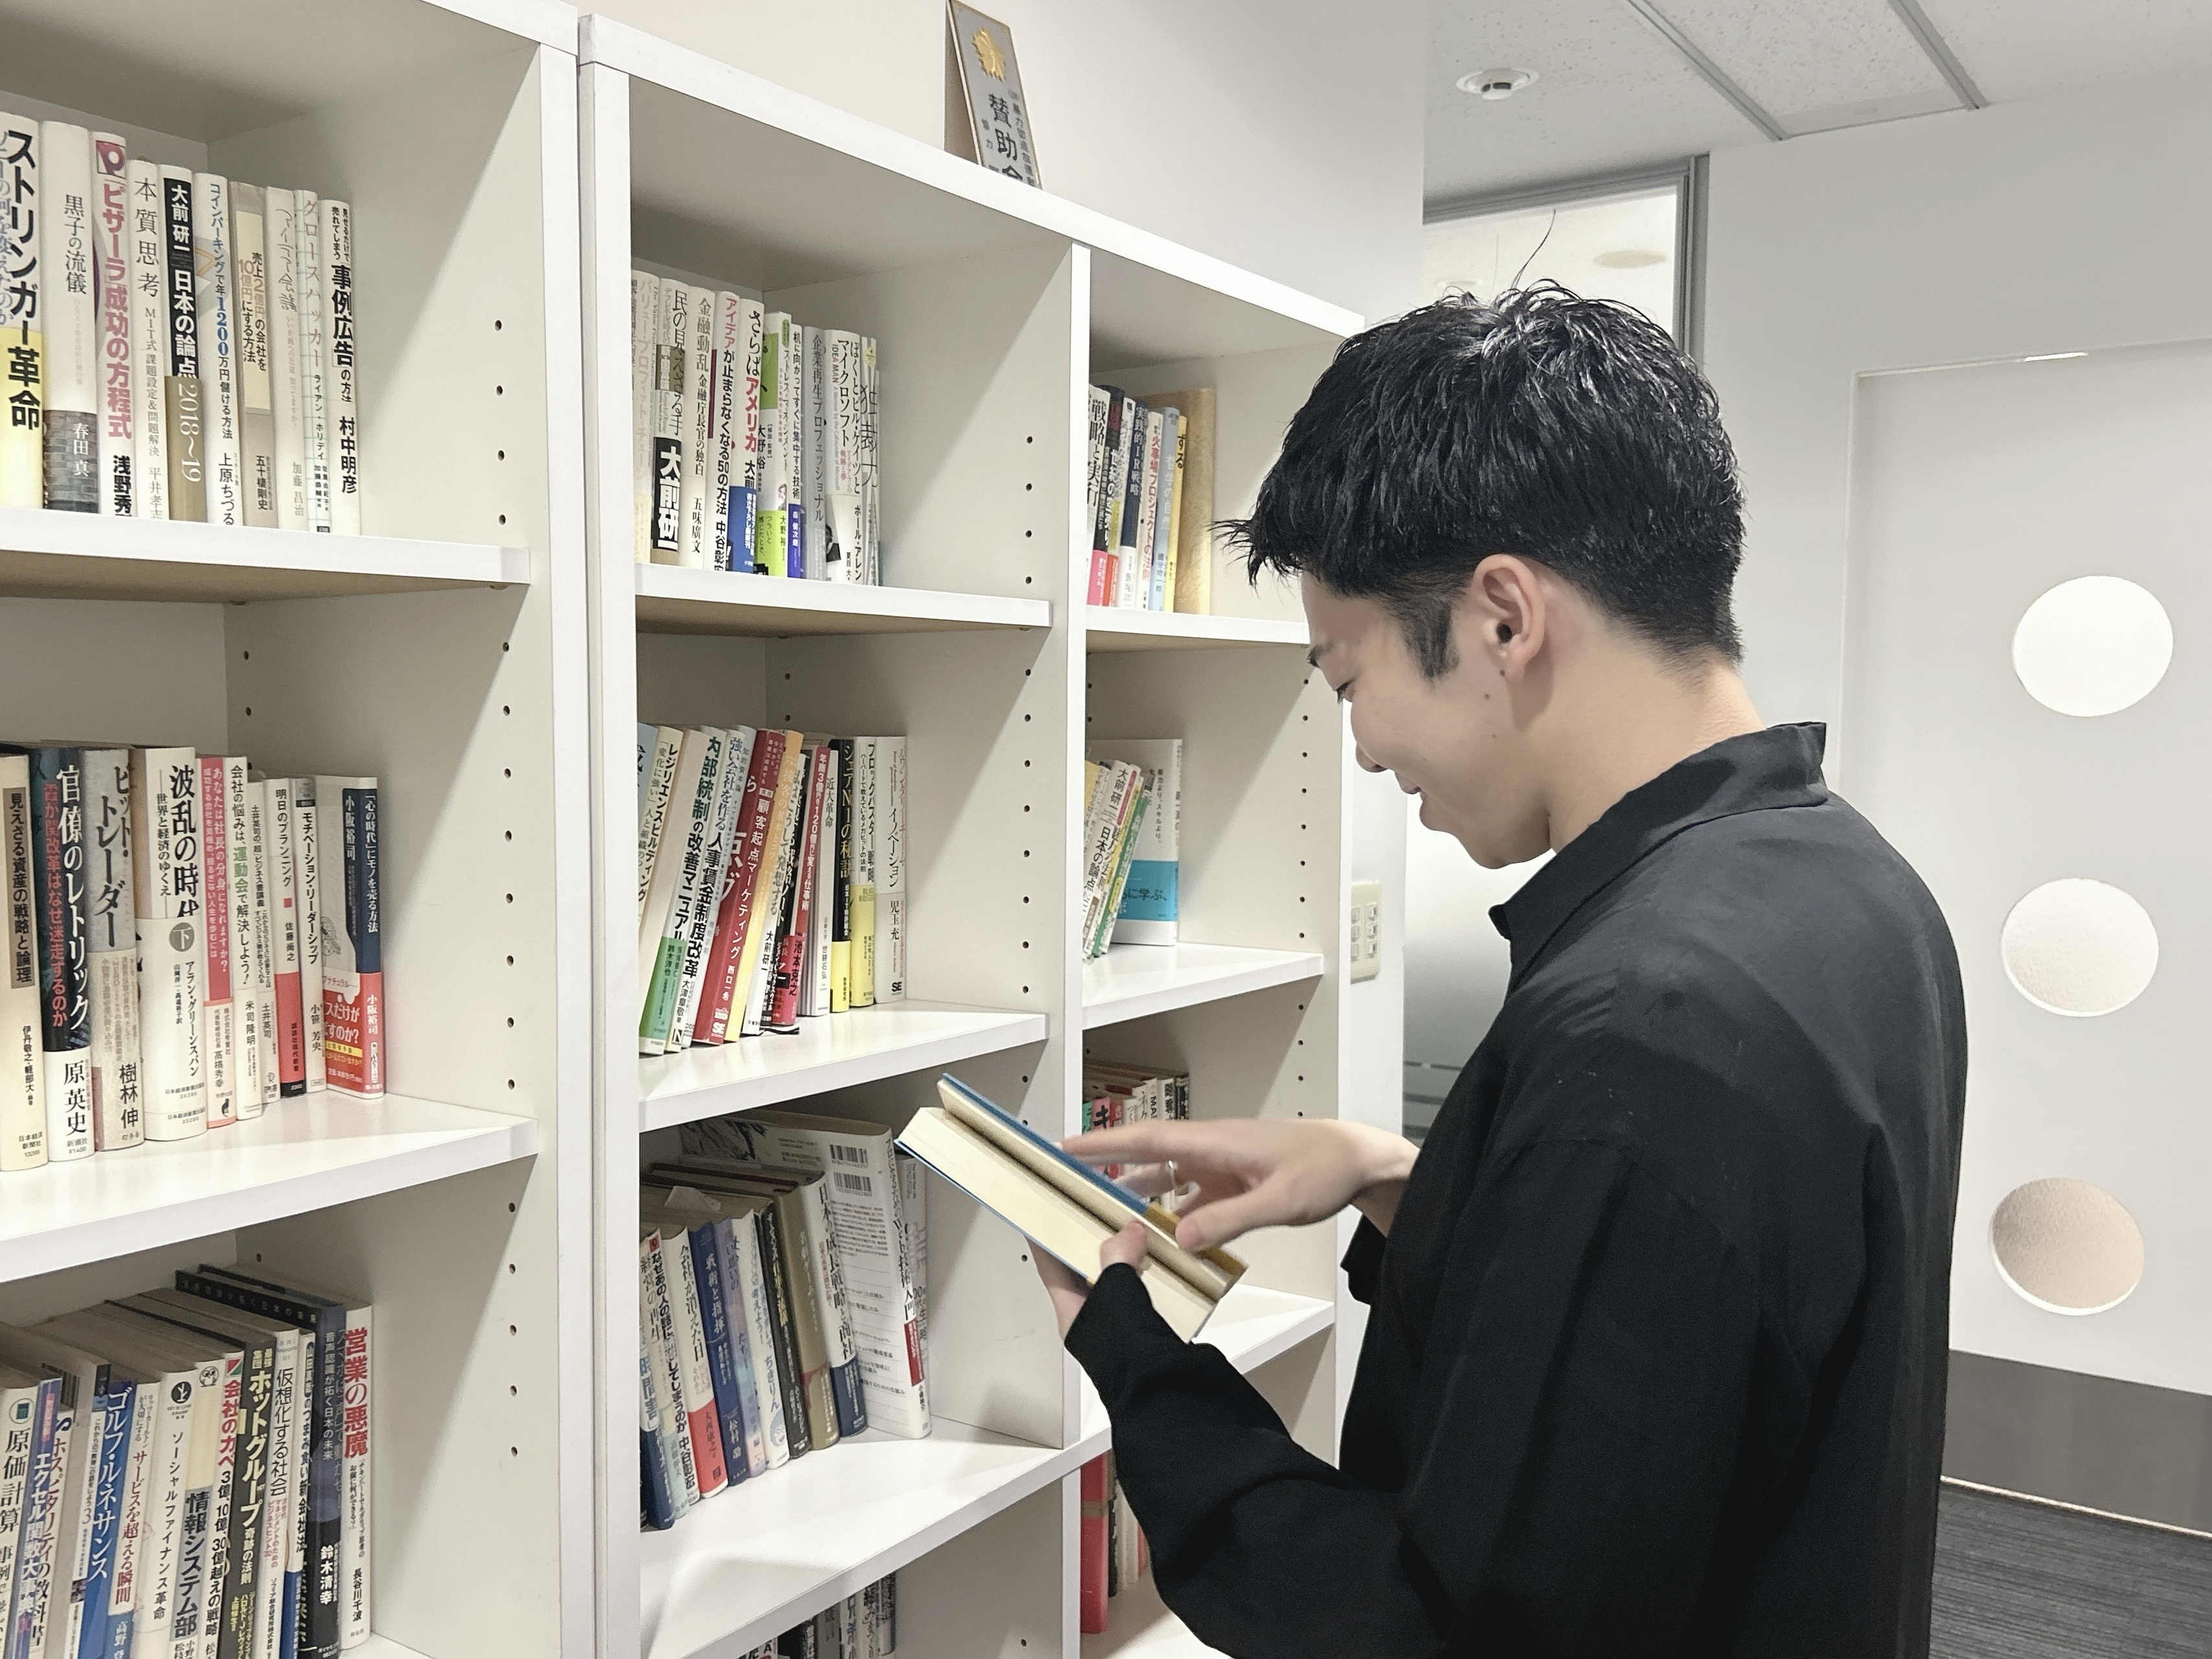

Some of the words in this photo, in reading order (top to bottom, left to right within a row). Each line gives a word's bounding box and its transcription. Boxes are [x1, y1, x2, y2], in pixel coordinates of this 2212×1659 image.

[7, 130, 41, 430] ストリンガー革命
[64, 194, 86, 294] 黒子の流儀
[134, 177, 160, 297] 本質思考
[170, 183, 191, 252] 大前研一
[174, 269, 198, 380] 日本の論点
[304, 199, 322, 367] グロースハッカー
[696, 297, 711, 373] 金融動乱
[716, 297, 737, 516] アイデアが止まらなくなる50の方法
[745, 310, 762, 454] さらばアメリカ
[838, 339, 850, 447] マイクロソフト
[113, 455, 132, 516] 浅野秀
[218, 452, 235, 526] 上原ちづる
[339, 415, 358, 494] 村中明彦
[657, 445, 681, 551] 大前研一
[95, 795, 126, 948] トレーダー
[169, 765, 200, 918] 波乱の時代
[275, 788, 292, 887] 明日のプランニング
[638, 743, 678, 902] レジリエンスビルディング
[11, 793, 31, 984] 見えざる資産の戦略と論理
[56, 764, 89, 1030] 官僚のレトリック
[301, 811, 320, 965] モチベーション・リーダーシップ
[185, 960, 200, 1077] アラン・グリーンスパン
[64, 1060, 87, 1137] 原英史
[119, 1063, 139, 1130] 樹林伸
[217, 1378, 241, 1467] 会社のカベ
[240, 1369, 272, 1528] ホットグループ
[270, 1367, 294, 1497] 仮想化する社会
[343, 1326, 368, 1459] 営業の悪魔
[0, 1428, 31, 1534] 原価計算
[86, 1386, 133, 1583] ゴルフ・ルネサンス
[153, 1431, 184, 1621] ソーシャルファイナンス革命
[174, 1491, 211, 1639] 情報システム部
